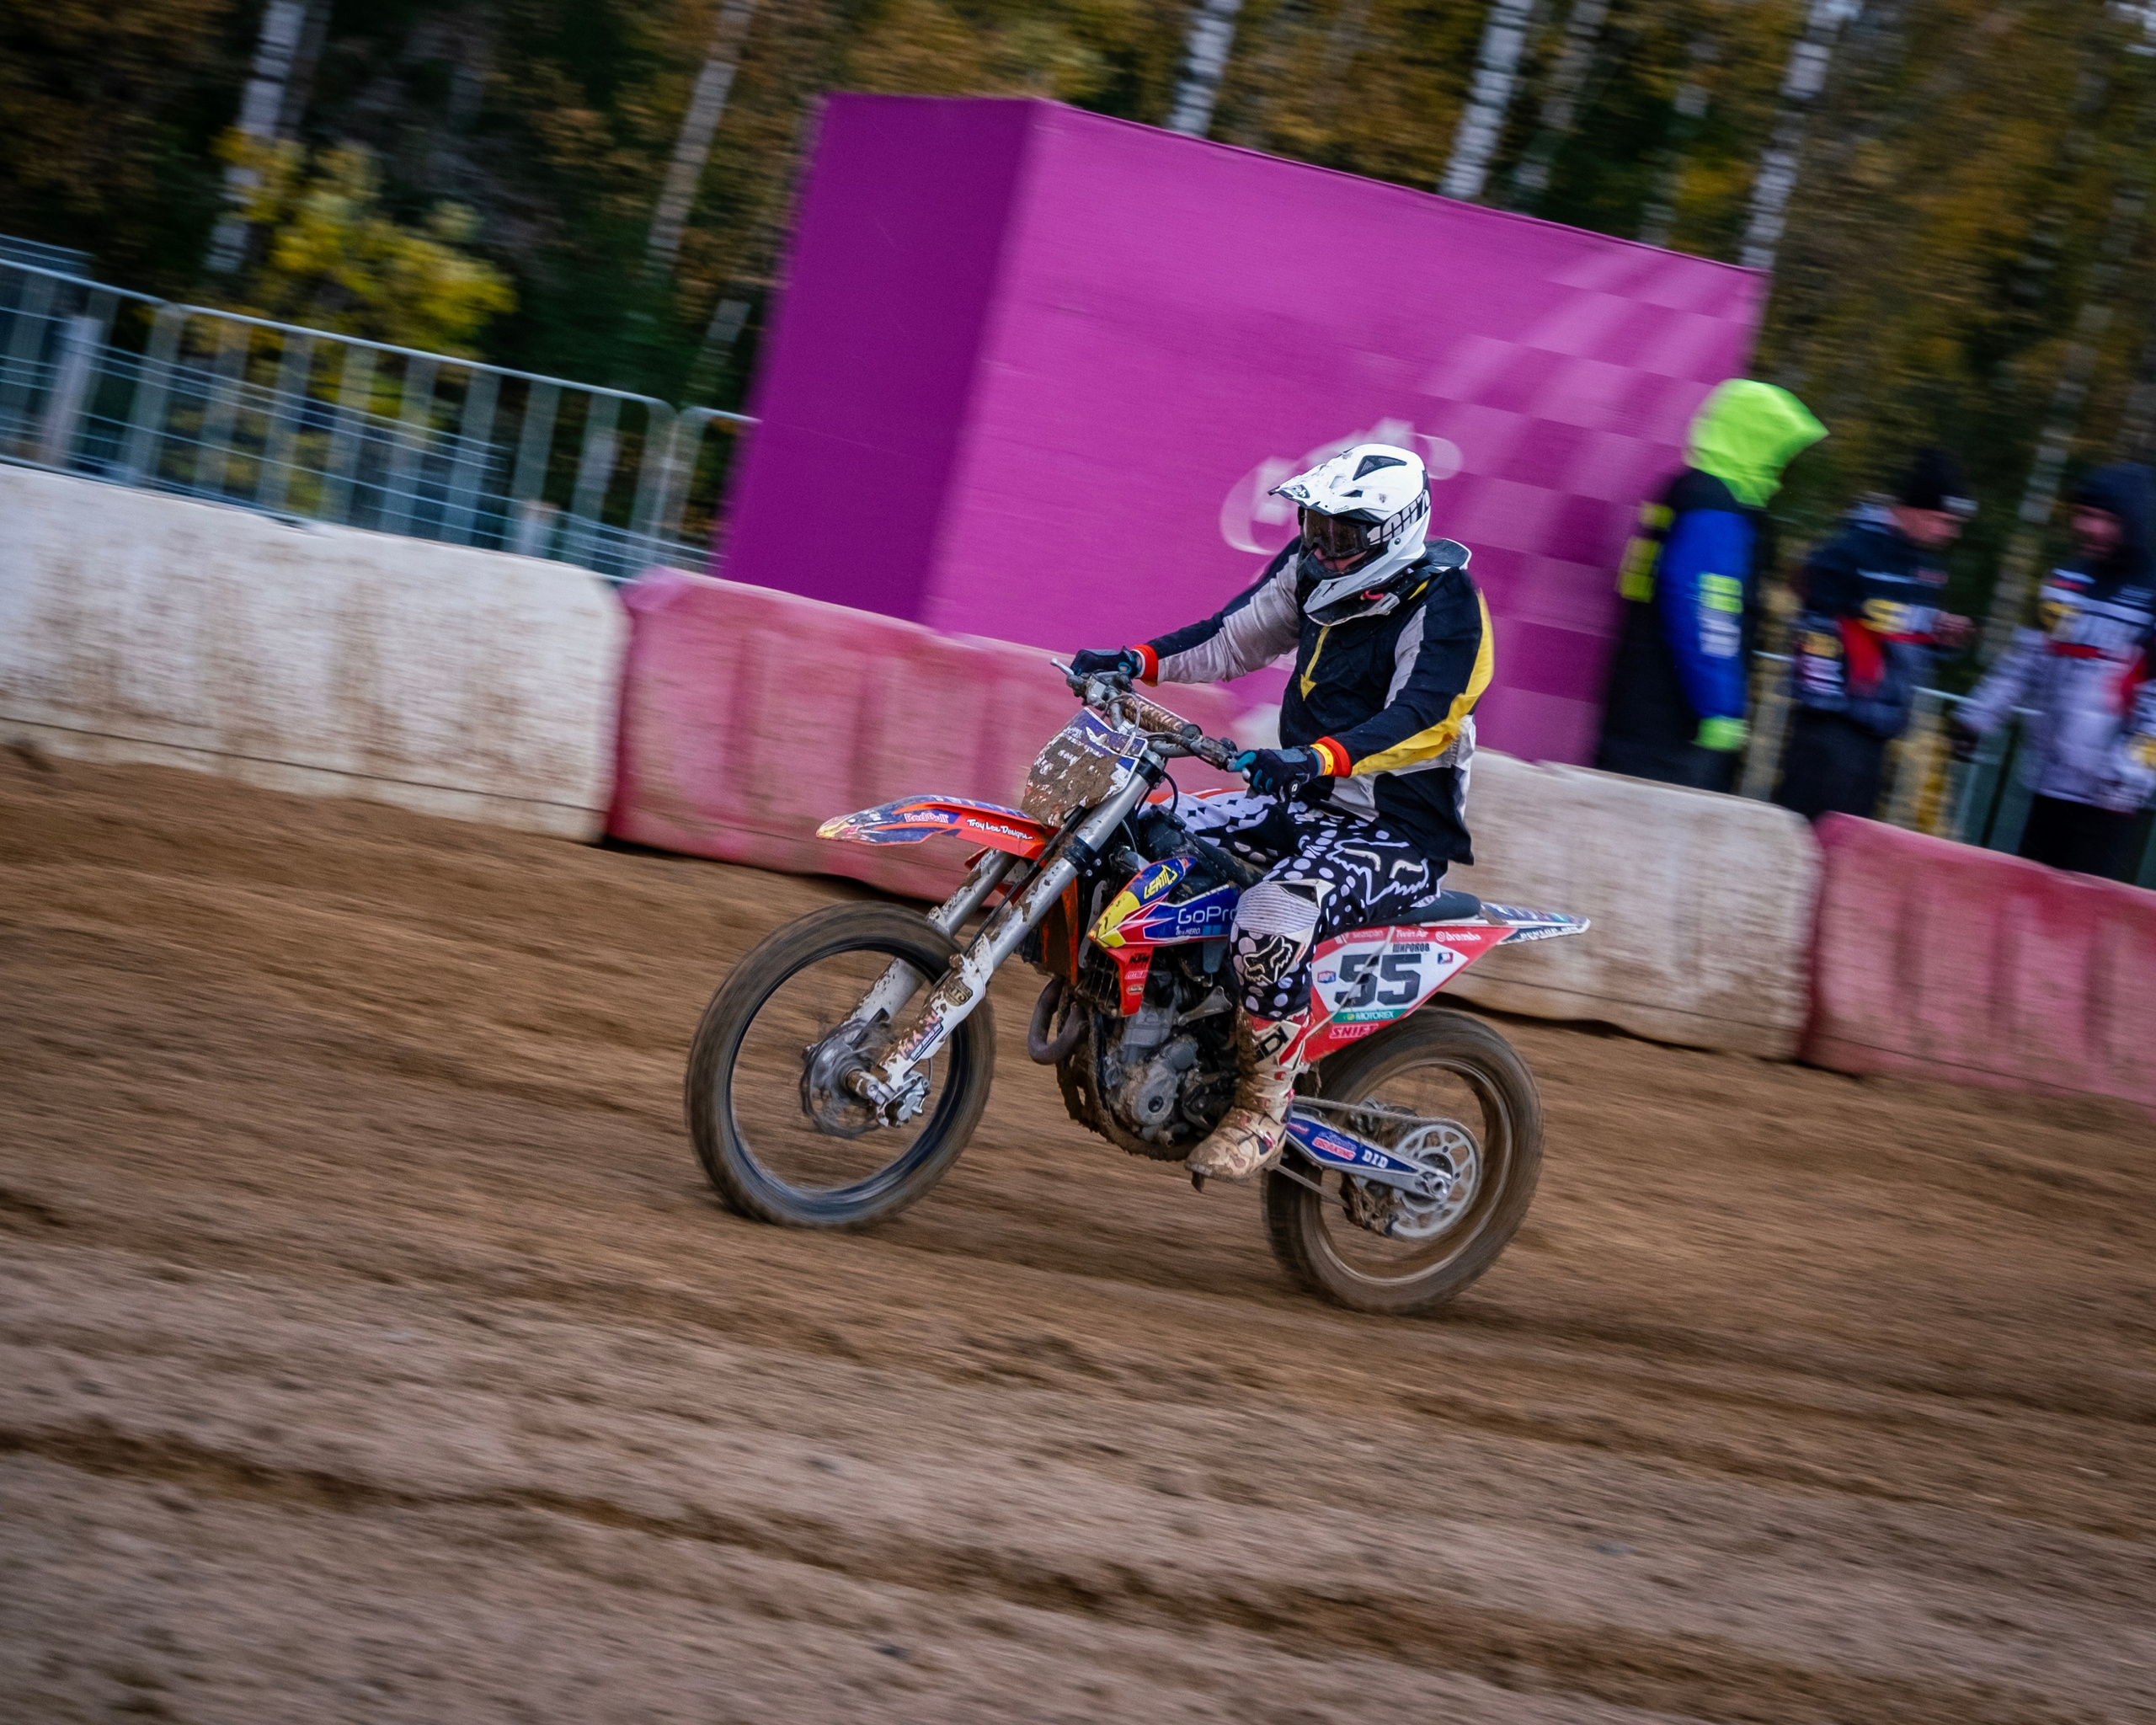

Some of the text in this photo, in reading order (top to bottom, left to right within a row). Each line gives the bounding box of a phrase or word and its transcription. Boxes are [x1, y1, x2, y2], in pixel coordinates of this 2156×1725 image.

[967, 819, 1033, 840] Troy Lee Designs
[1445, 932, 1481, 942] brembo
[1392, 943, 1430, 953] ШИРОКОВ
[1334, 953, 1422, 1007] 55
[1356, 1011, 1394, 1021] MOTOREX
[1331, 1025, 1378, 1037] SHIFT
[1362, 1148, 1389, 1169] DID
